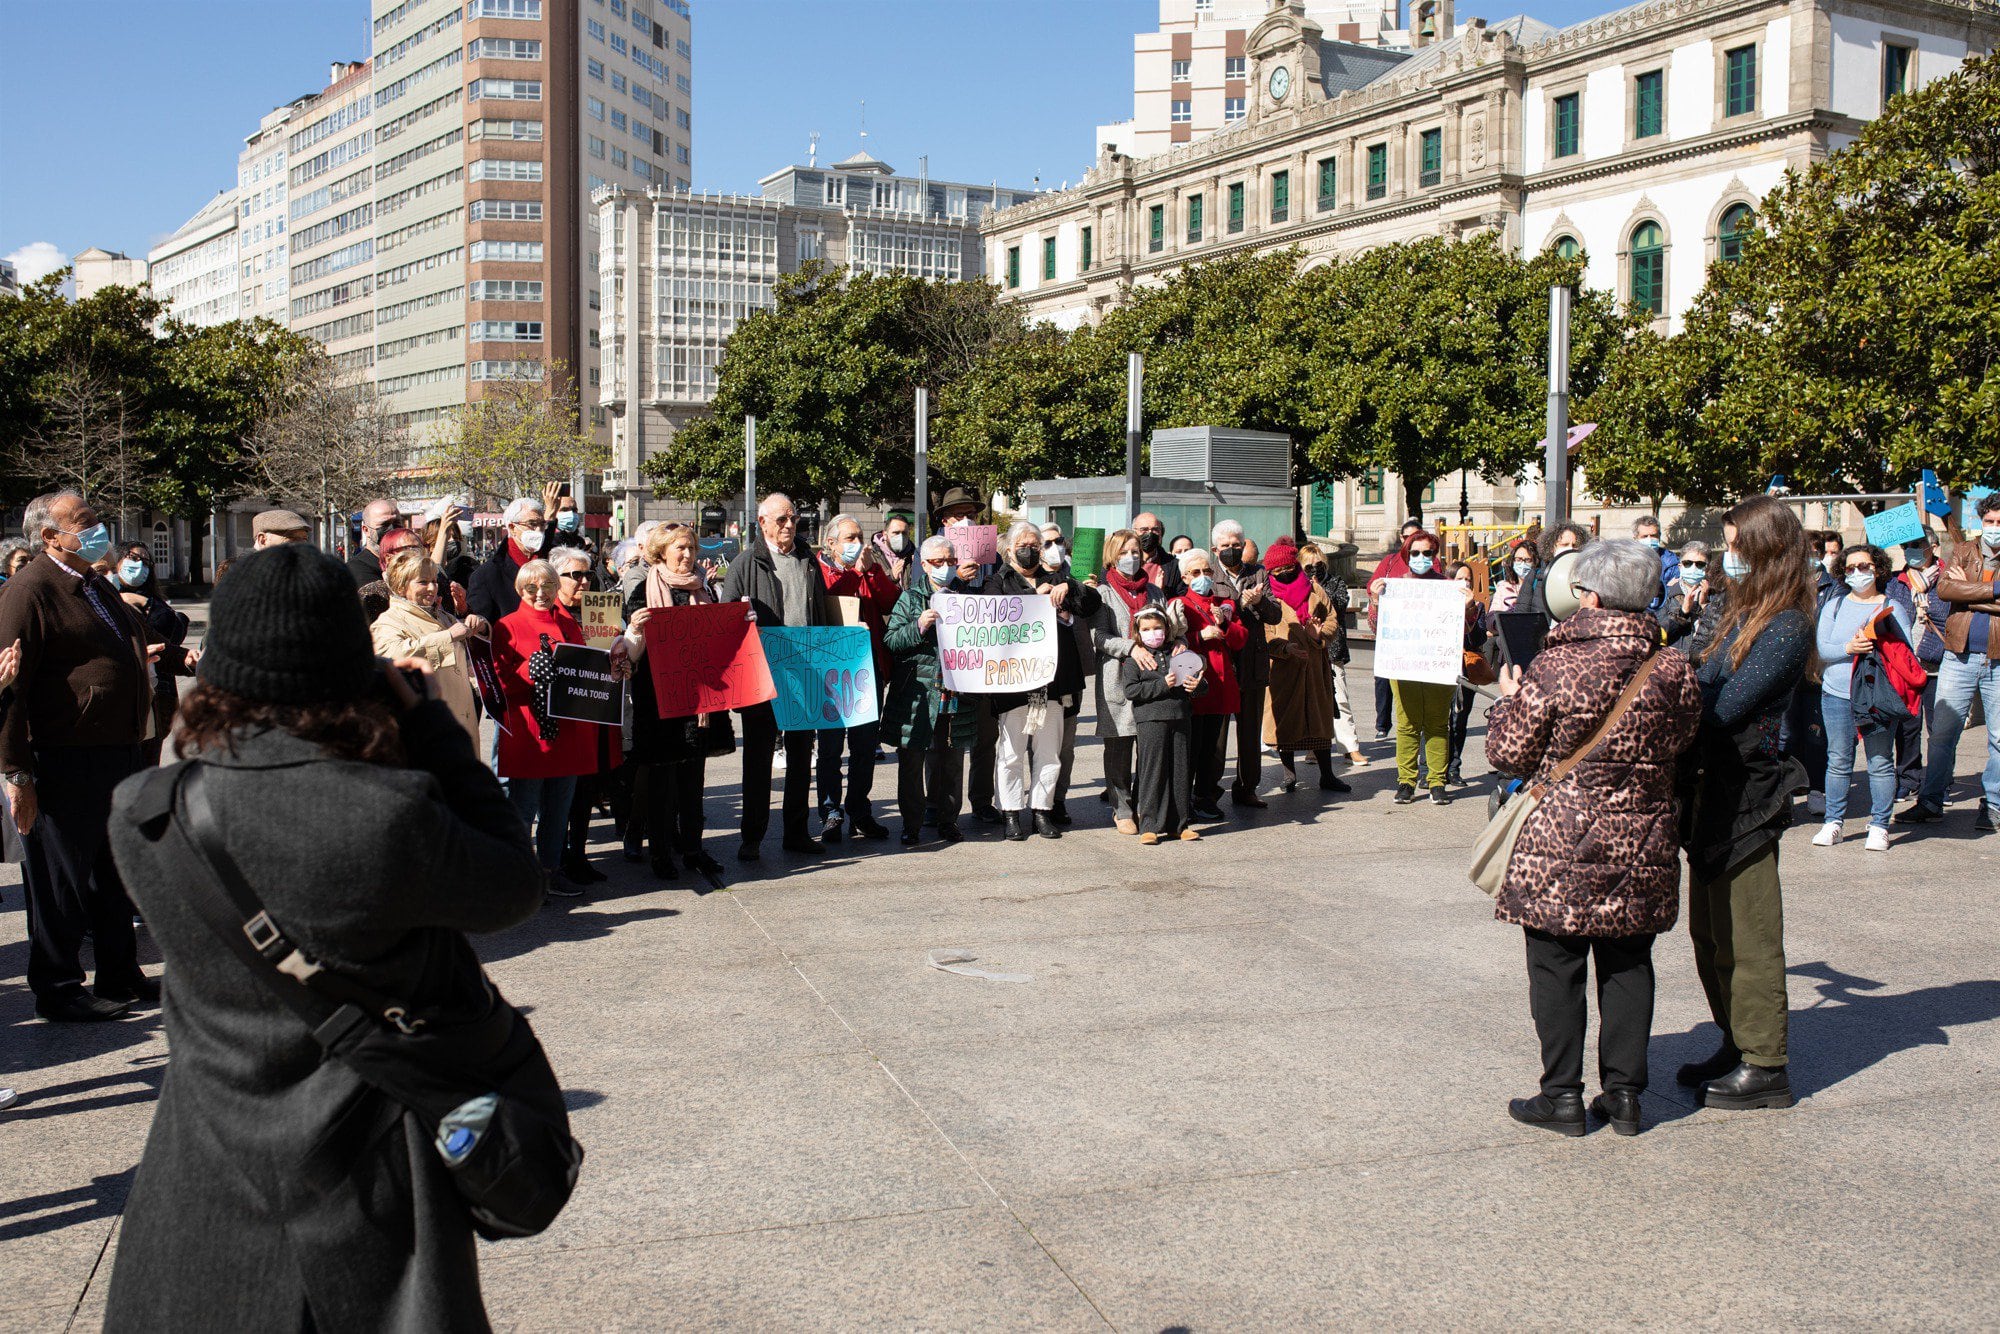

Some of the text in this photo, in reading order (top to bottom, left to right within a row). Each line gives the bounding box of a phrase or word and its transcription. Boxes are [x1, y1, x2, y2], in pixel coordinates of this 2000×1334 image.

[954, 542, 990, 560] ÚBLICA
[584, 594, 621, 608] BASTA
[590, 611, 605, 624] DE
[945, 597, 1024, 624] SOMOS
[956, 621, 1046, 647] MAIORES
[557, 666, 619, 684] POR UNHA BAN
[943, 648, 1056, 685] NON PARVOS
[567, 686, 588, 697] PARA
[771, 667, 872, 727] ABUSOS
